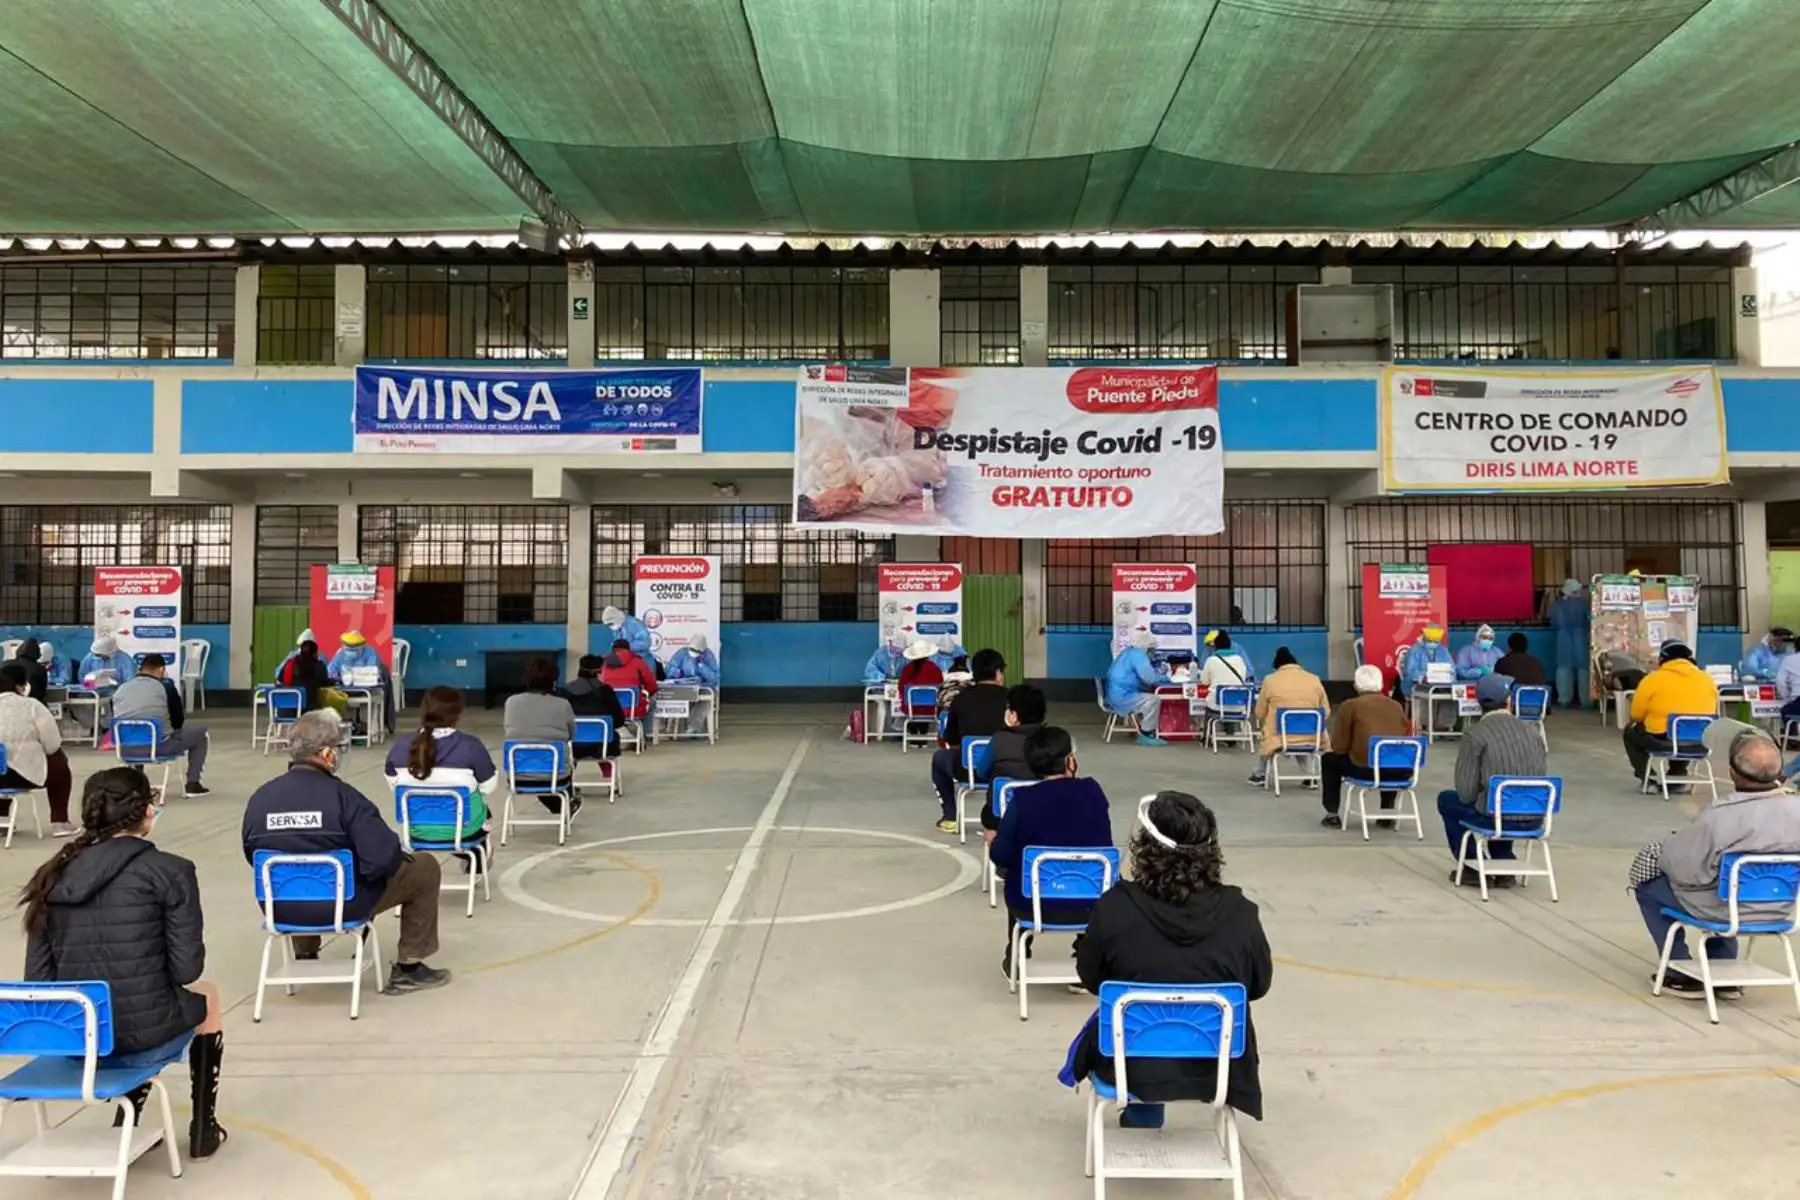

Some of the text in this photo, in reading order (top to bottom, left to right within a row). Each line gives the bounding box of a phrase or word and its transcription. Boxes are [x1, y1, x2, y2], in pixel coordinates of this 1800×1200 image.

[1101, 374, 1196, 389] Municipalidad de
[596, 386, 672, 398] DE TODOS
[1087, 387, 1147, 403] Puente
[378, 377, 561, 422] MINSA
[1414, 408, 1688, 431] CENTRO DE COMANDO
[913, 427, 1068, 461] Despistaje
[1076, 426, 1162, 455] Covid
[1490, 434, 1567, 454] COVID
[1589, 433, 1618, 451] 19
[978, 464, 1151, 482] Tratamiento oportuno
[1466, 459, 1639, 478] DIRIS LIMA NORTE
[991, 486, 1133, 509] GRATUITO
[640, 562, 705, 574] PREVENCIÓN
[883, 568, 955, 577] Recomendaciones
[1116, 568, 1189, 577] Recomendaciones
[100, 571, 173, 580] Recomendaciones
[907, 576, 940, 584] prevenir
[1140, 576, 1175, 584] prevenir
[124, 579, 158, 587] prevenir
[650, 583, 706, 593] CONTRA EL
[113, 586, 142, 594] COVID
[149, 586, 160, 594] 19
[656, 592, 683, 600] COVID
[690, 592, 699, 600] 19
